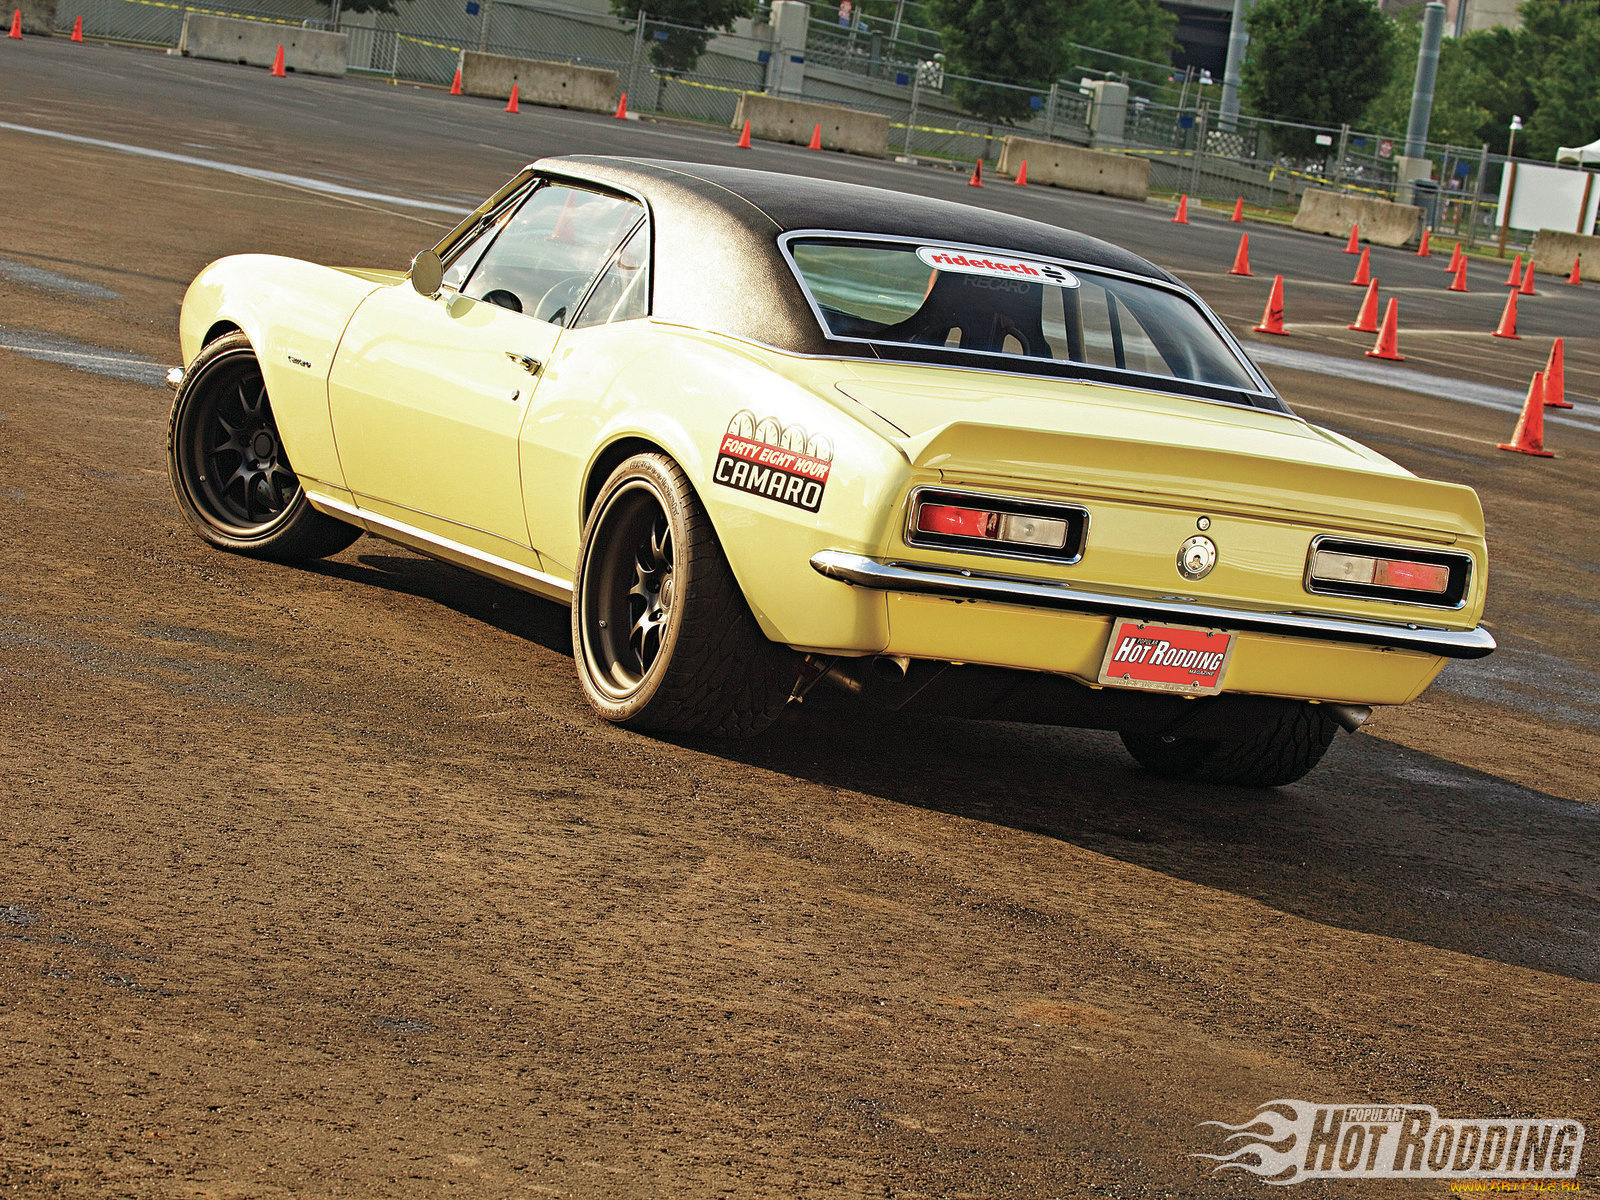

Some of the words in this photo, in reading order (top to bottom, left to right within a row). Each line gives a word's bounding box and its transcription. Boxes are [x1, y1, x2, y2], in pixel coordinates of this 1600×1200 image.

[931, 253, 1040, 277] ridetech
[963, 276, 1031, 295] RECARO
[722, 437, 761, 458] FORTY
[758, 448, 796, 468] EIGHT
[793, 457, 829, 479] HOUR
[715, 456, 822, 508] CAMARO
[1113, 637, 1153, 663] HOT
[1148, 640, 1224, 671] RODDING
[1136, 638, 1159, 646] POPULAR
